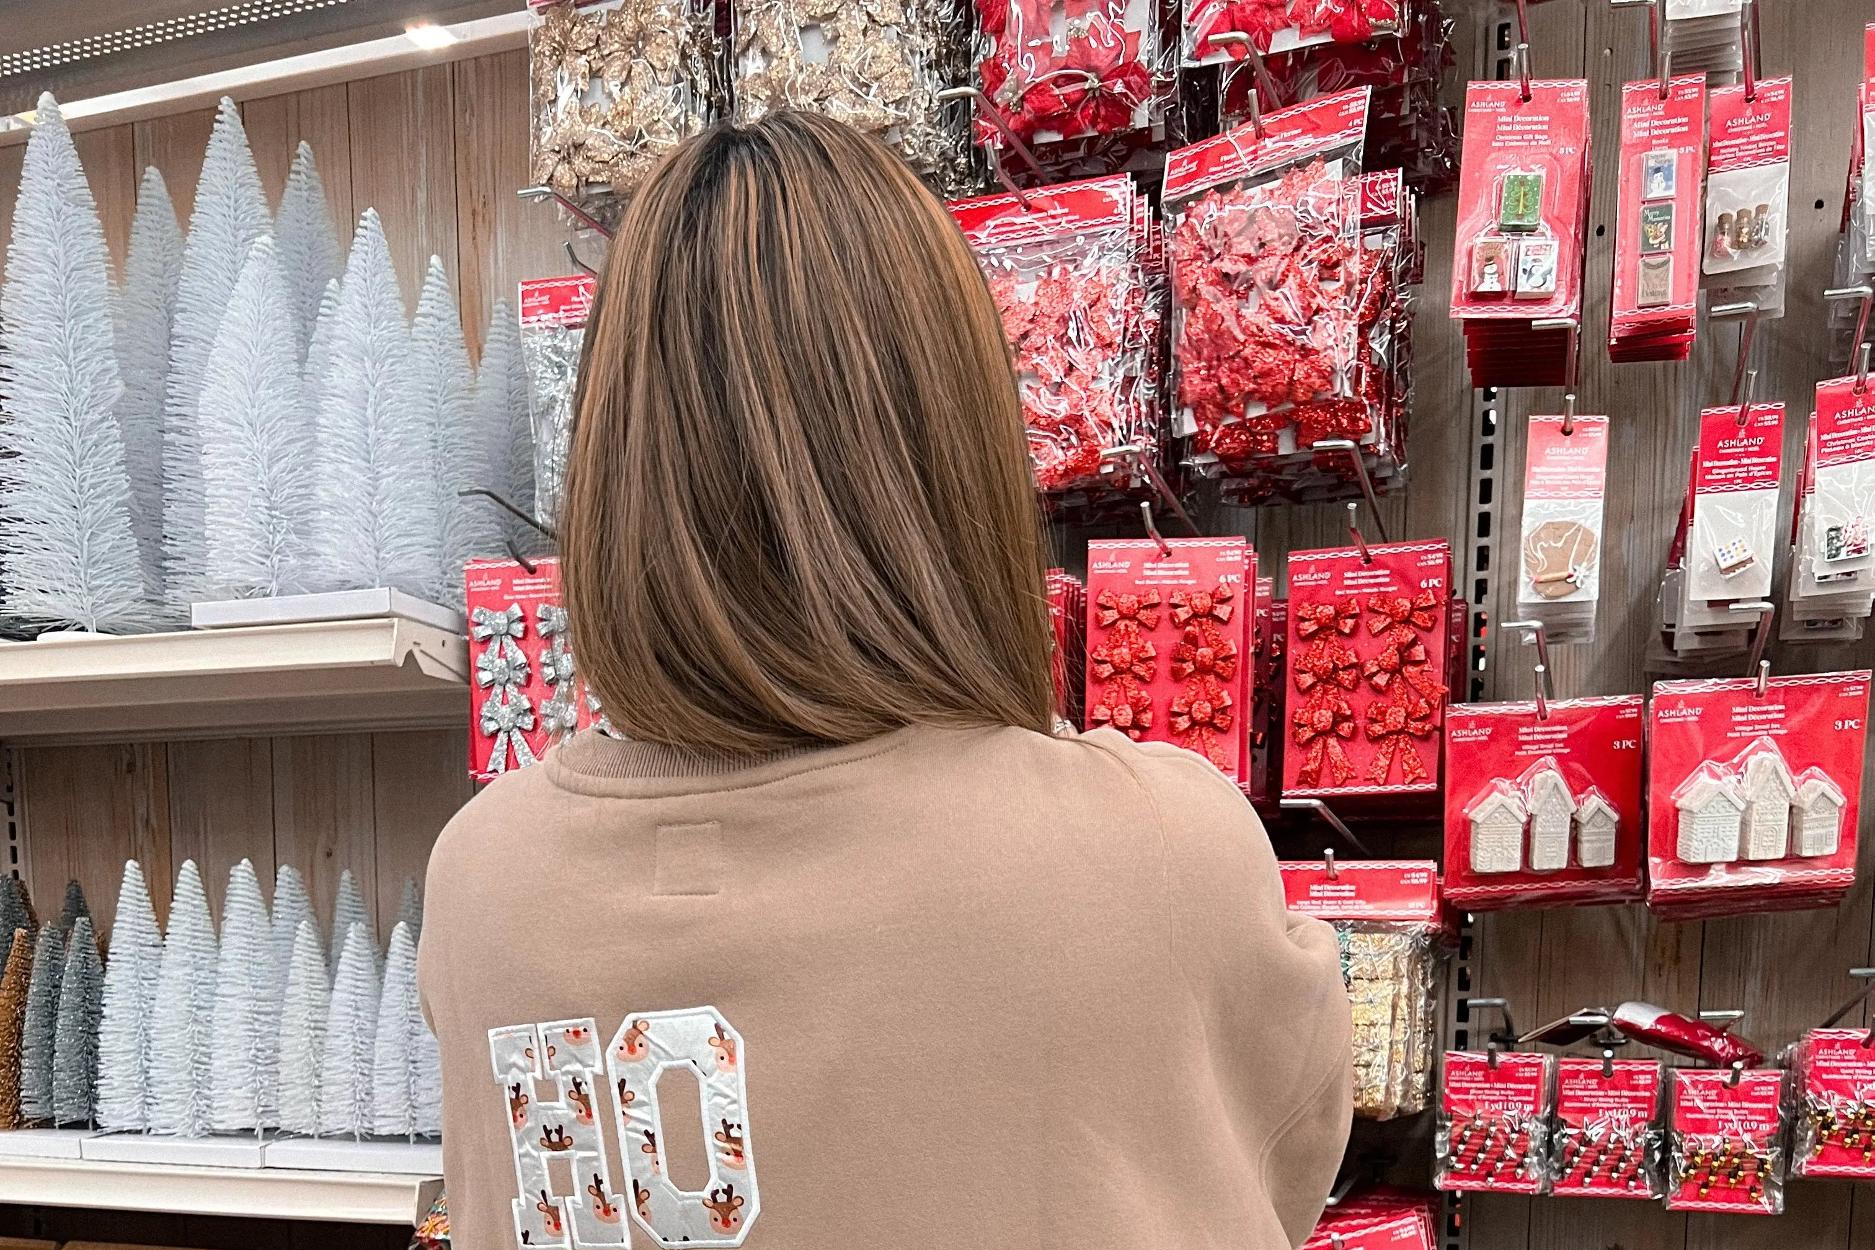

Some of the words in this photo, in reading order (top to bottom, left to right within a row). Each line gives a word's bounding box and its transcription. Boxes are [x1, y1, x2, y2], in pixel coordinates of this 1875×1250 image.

[1627, 104, 1665, 114] ASHLAND
[1651, 117, 1688, 126] Decoration
[1725, 113, 1771, 127] ASHLAND
[1633, 130, 1649, 138] Mini
[1835, 406, 1875, 419] ASHLAN
[1717, 438, 1763, 448] ASHLAND
[1227, 574, 1241, 583] PC
[1292, 572, 1331, 581] ASHLAND
[1429, 578, 1442, 588] PC
[1658, 708, 1702, 718] ASHLAND
[1844, 719, 1860, 729] PC
[1451, 728, 1491, 737] ASHLAND
[1622, 740, 1636, 749] PC
[1638, 1110, 1647, 1118] m
